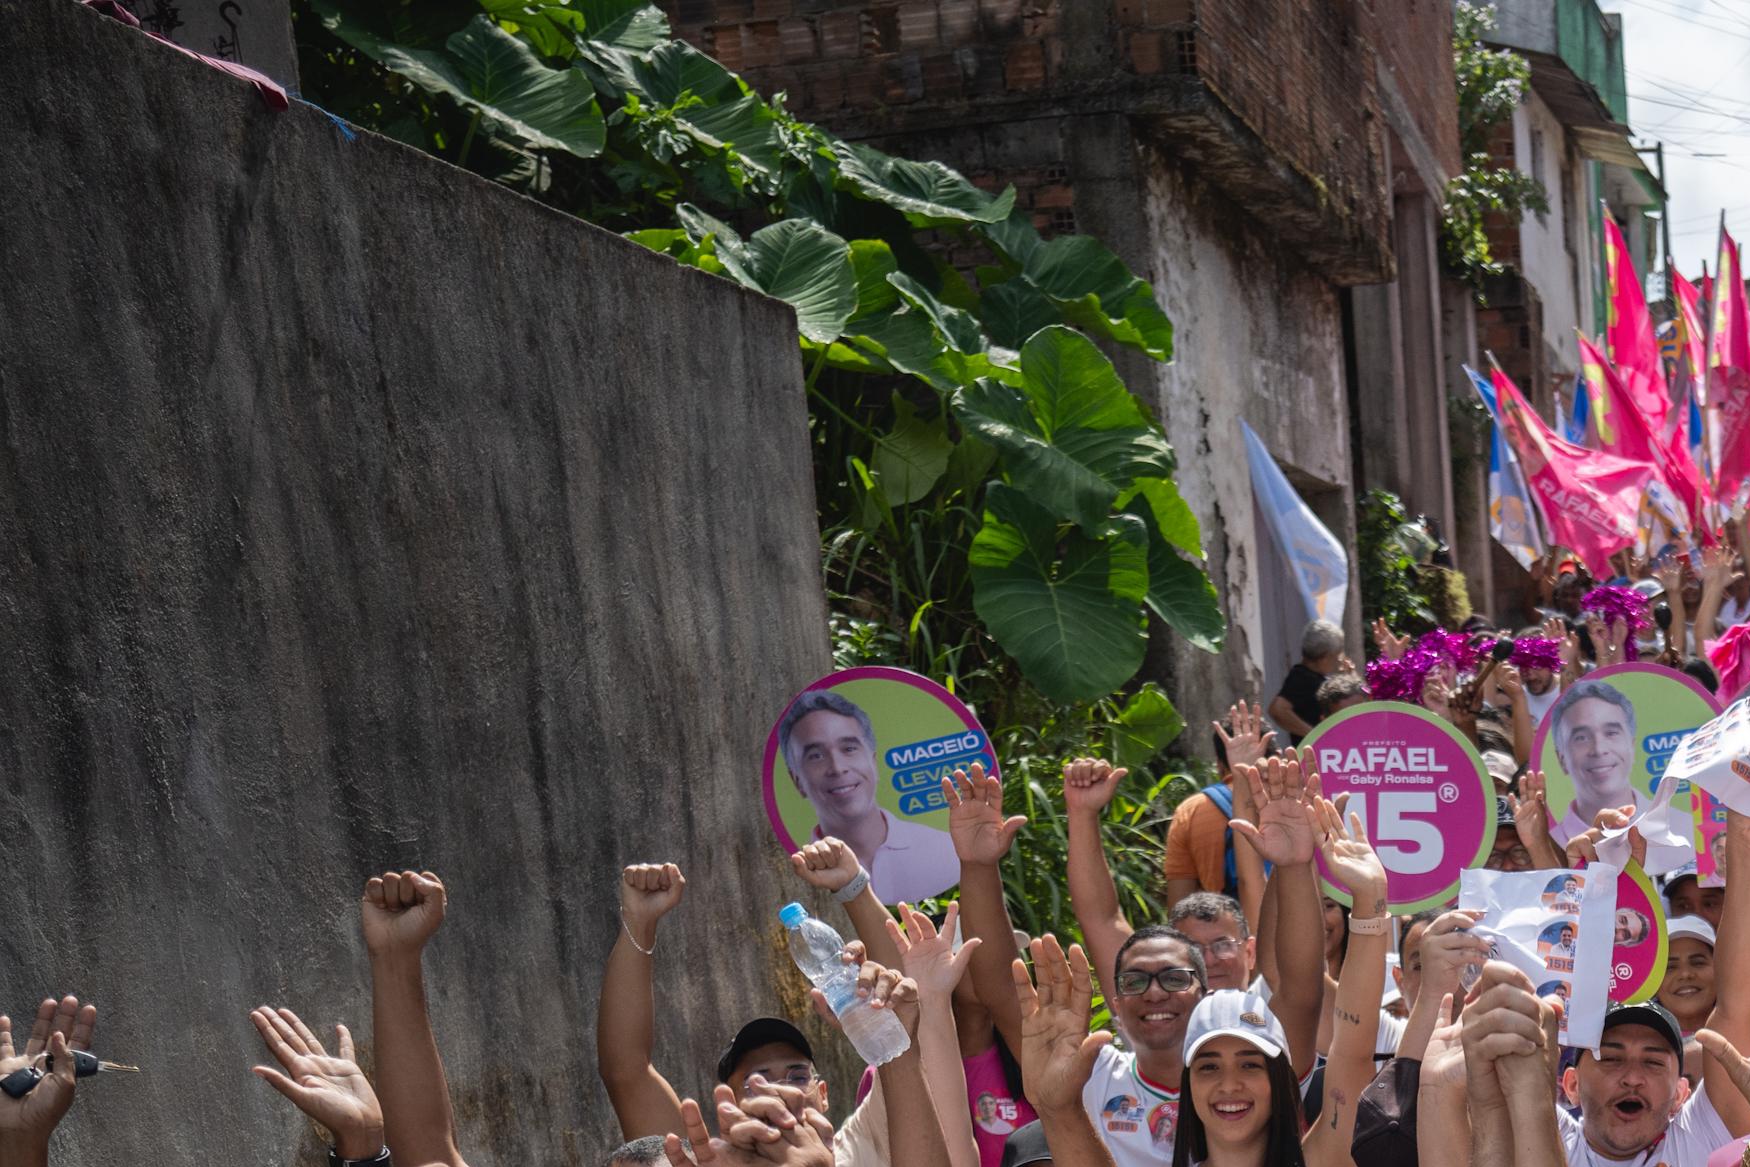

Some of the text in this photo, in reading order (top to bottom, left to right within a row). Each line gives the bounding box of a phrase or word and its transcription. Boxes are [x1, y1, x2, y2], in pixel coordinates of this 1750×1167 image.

[890, 732, 980, 766] MACEIÓ
[1319, 747, 1449, 774] RAFAEL
[1349, 775, 1382, 786] Gaby
[1385, 774, 1434, 785] Ronalsa
[908, 796, 925, 812] A
[998, 1105, 1017, 1120] 15
